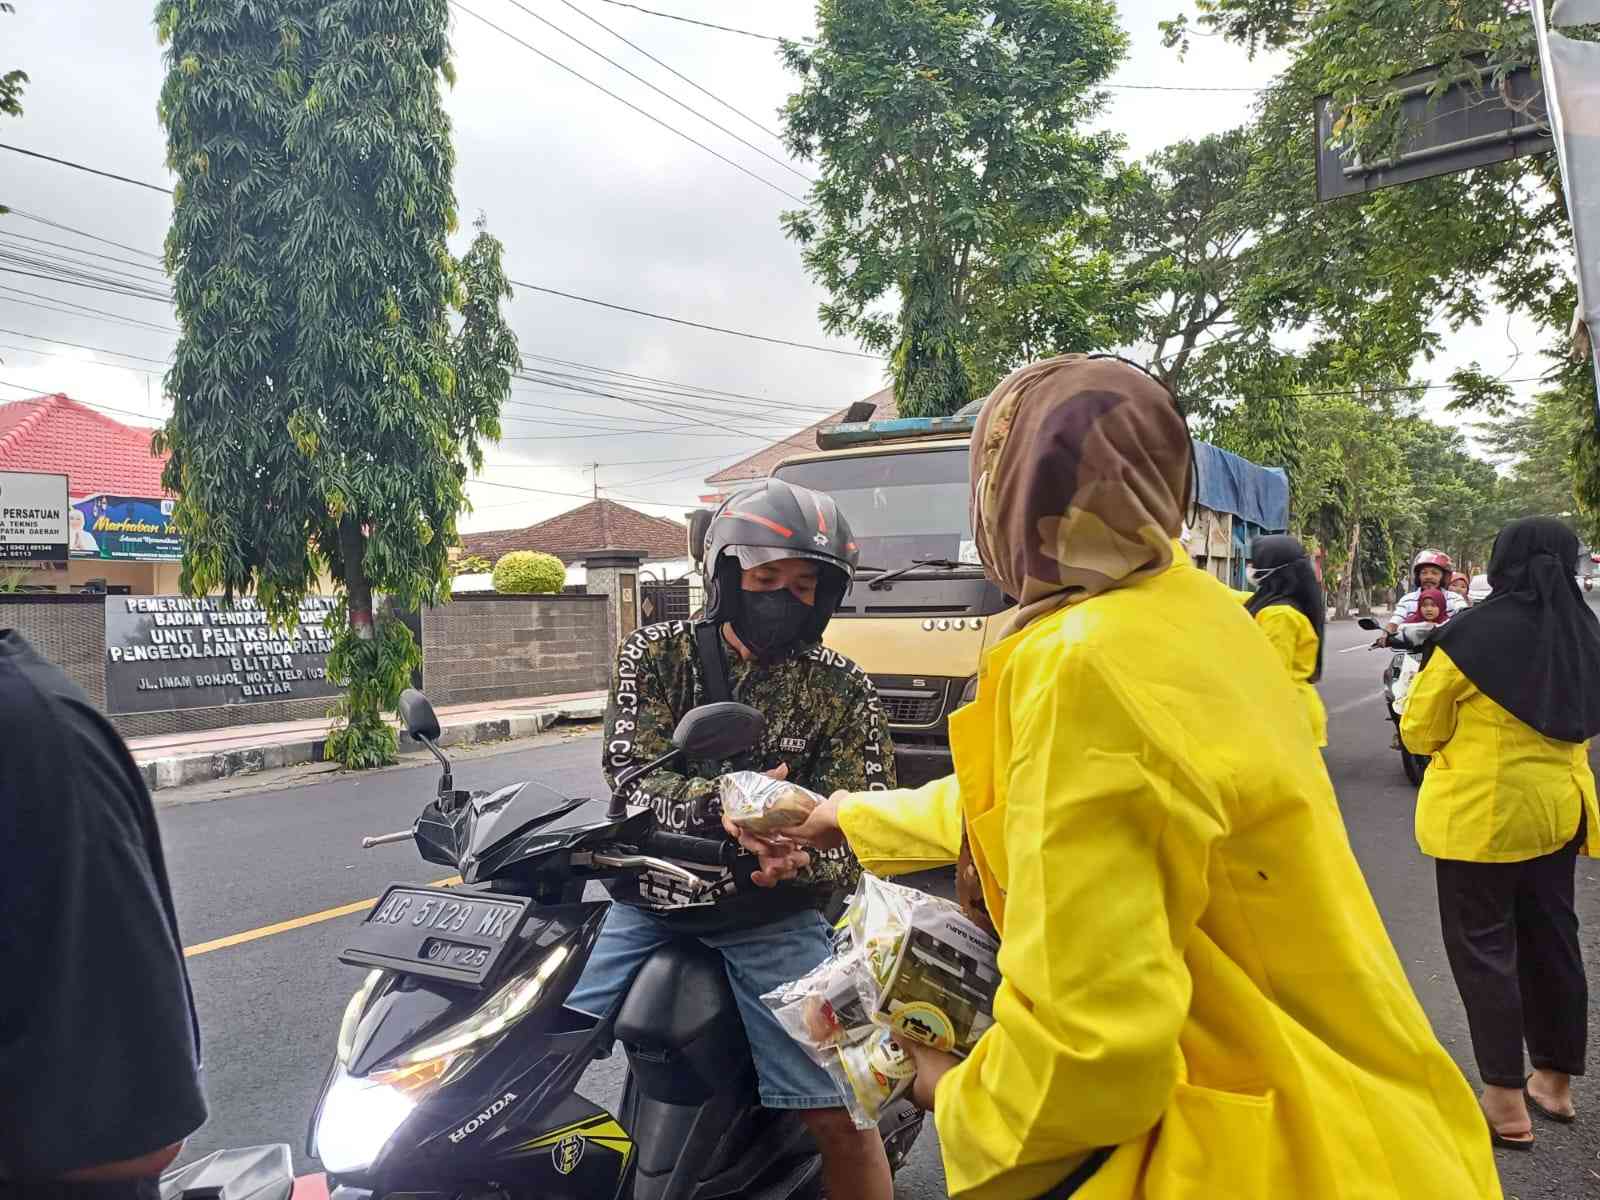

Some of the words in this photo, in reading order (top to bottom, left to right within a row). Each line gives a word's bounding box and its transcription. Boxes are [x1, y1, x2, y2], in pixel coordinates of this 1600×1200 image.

[3, 508, 60, 520] PERSATUAN
[93, 515, 159, 534] Marhaban
[127, 598, 220, 612] PEMERINTAH
[154, 612, 204, 626] BADAN
[150, 629, 193, 644] UNIT
[202, 626, 302, 643] PELAKSANA
[110, 642, 236, 662] PENGELOLAAN
[230, 655, 294, 672] BLITAR
[196, 671, 243, 687] BONJOL
[267, 671, 276, 682] 5
[242, 681, 293, 697] BLITAR
[614, 719, 636, 736] &
[413, 899, 473, 932] 5129
[477, 906, 515, 938] NK
[448, 1092, 519, 1145] HONDA
